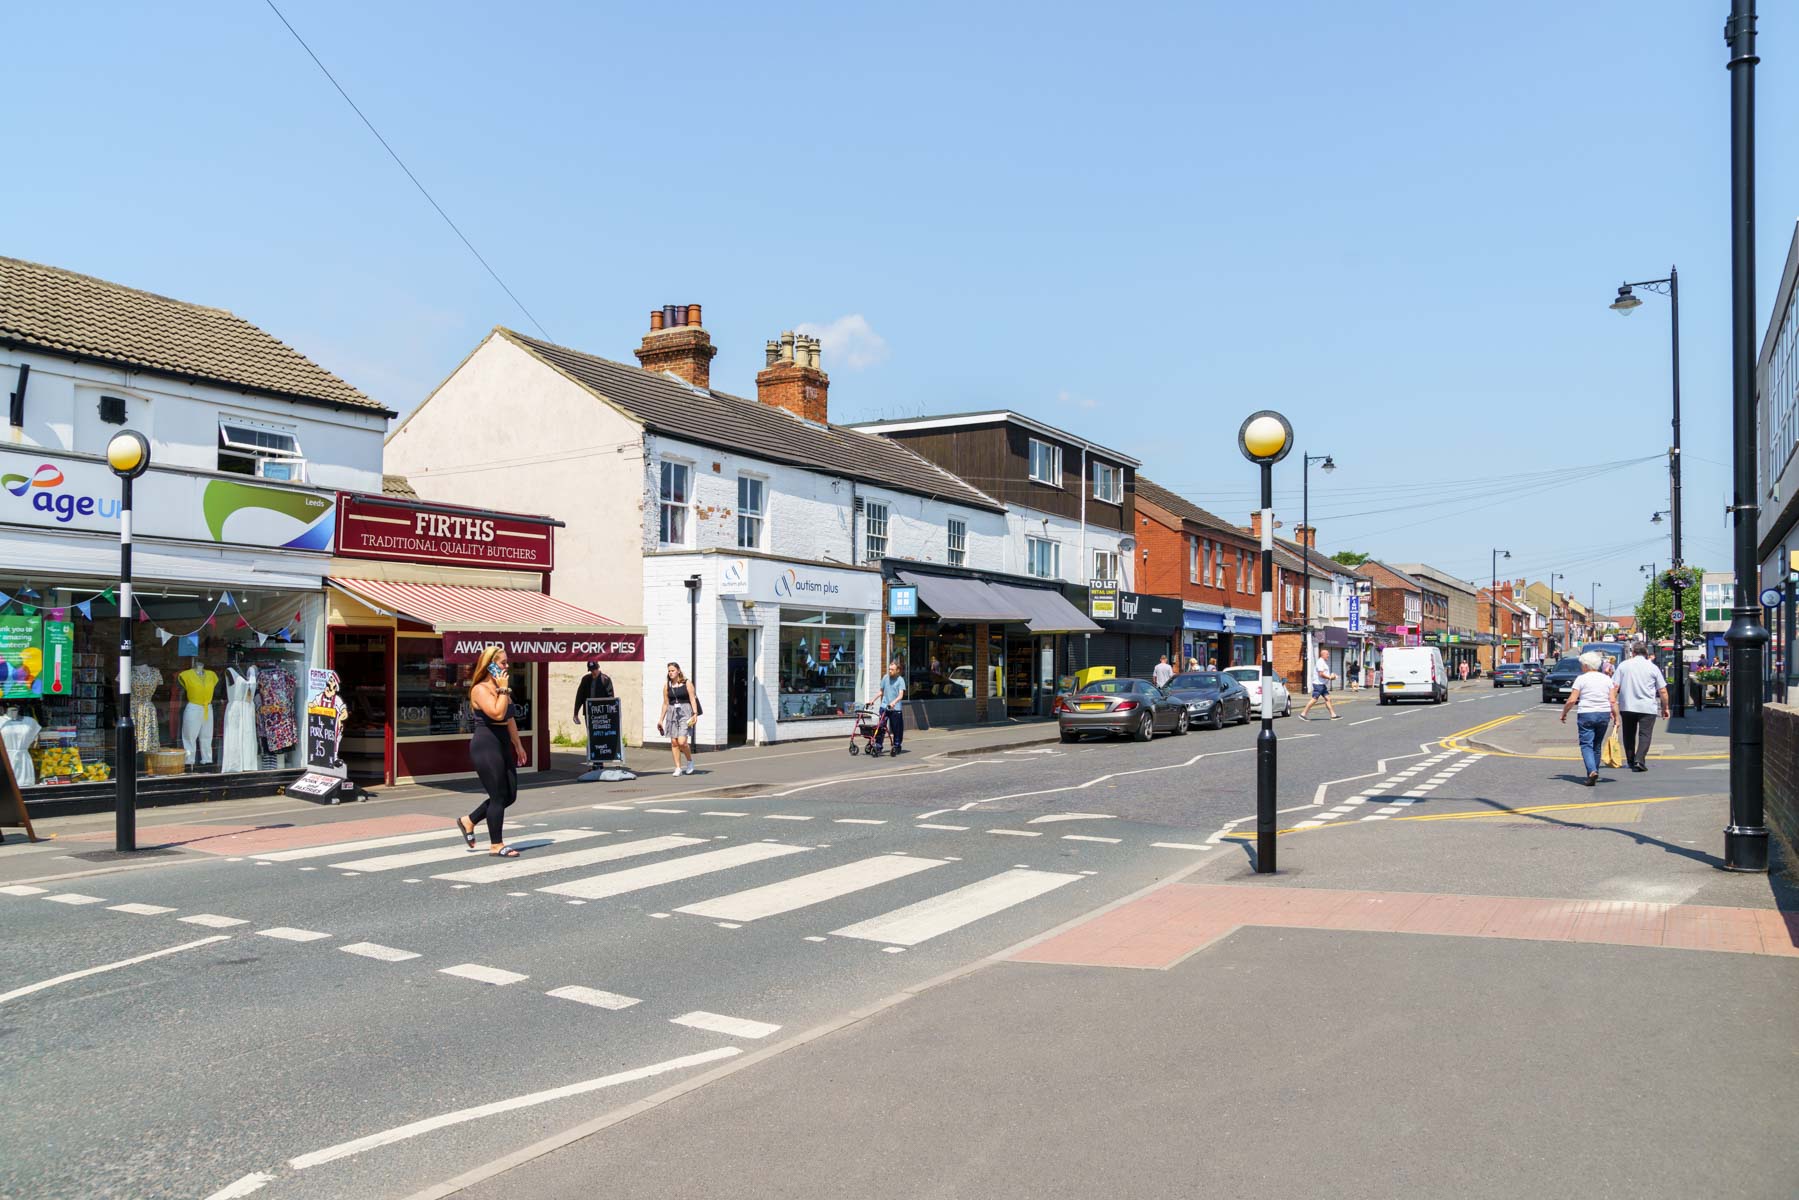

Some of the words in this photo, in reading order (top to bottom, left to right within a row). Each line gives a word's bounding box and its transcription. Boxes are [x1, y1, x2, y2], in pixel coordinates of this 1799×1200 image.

[33, 492, 94, 522] age
[305, 498, 325, 507] Leeds
[415, 513, 494, 542] FIRTHS
[361, 534, 438, 552] TRADITIONAL
[440, 541, 485, 556] QUALITY
[487, 546, 537, 560] BUTCHERS
[795, 581, 822, 593] autism
[823, 581, 839, 595] plus
[511, 641, 567, 654] WINNING
[572, 642, 605, 654] PORK
[611, 642, 636, 654] PIES
[311, 670, 326, 679] FIRTHS
[591, 705, 604, 713] PART
[606, 704, 618, 713] TIME
[318, 716, 324, 728] 4
[310, 726, 324, 738] PORK
[324, 729, 335, 740] PIES
